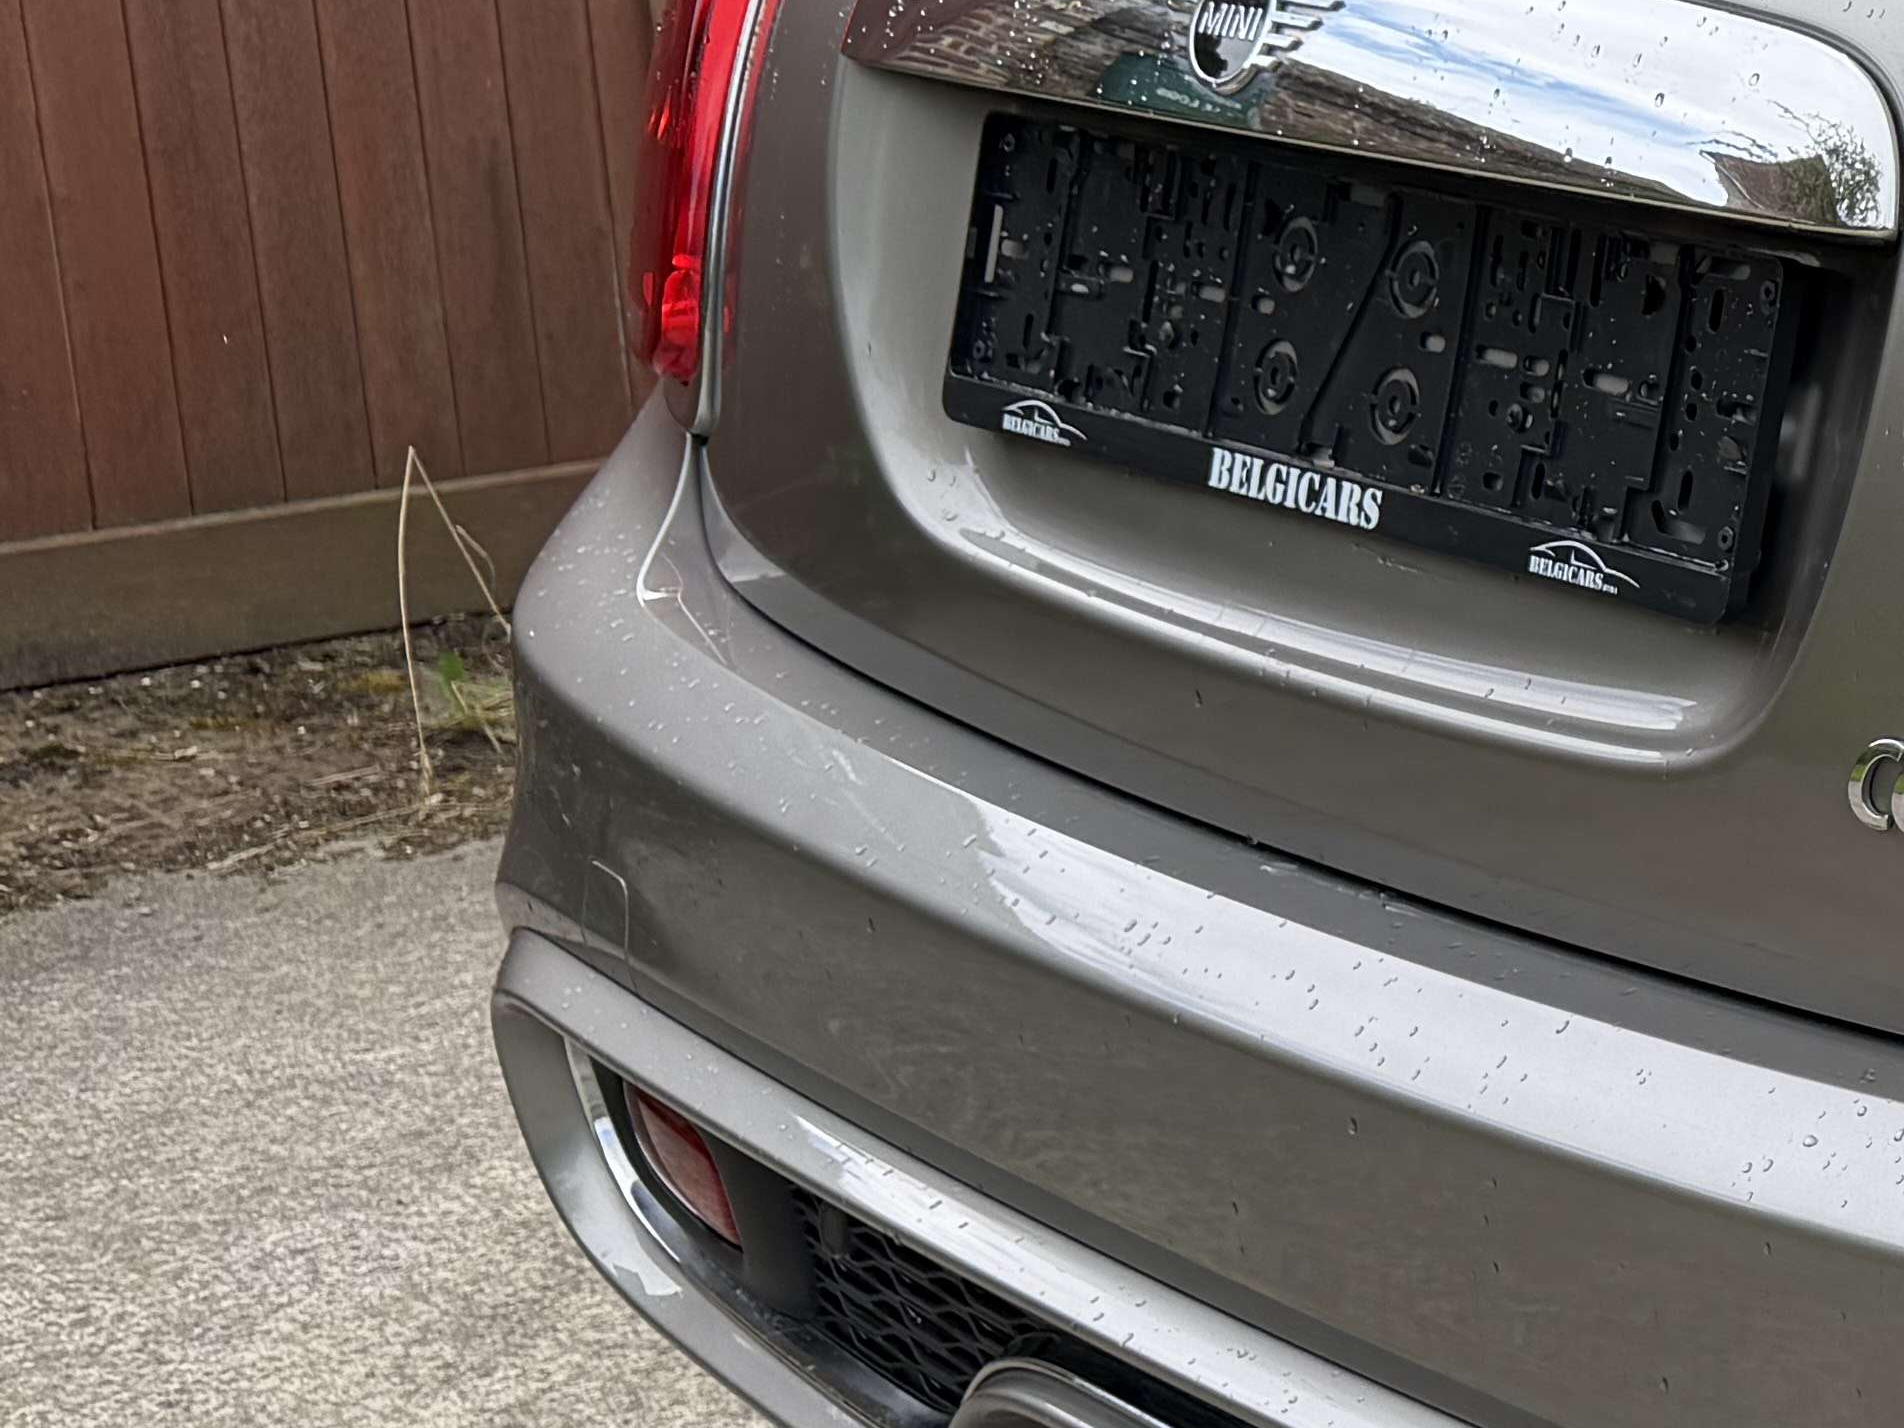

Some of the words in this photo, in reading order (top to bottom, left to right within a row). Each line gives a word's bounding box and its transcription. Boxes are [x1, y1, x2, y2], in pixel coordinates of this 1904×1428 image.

[1198, 1, 1263, 41] MINI
[1207, 446, 1383, 530] BELGICARS
[1528, 554, 1604, 590] BELGICARS
